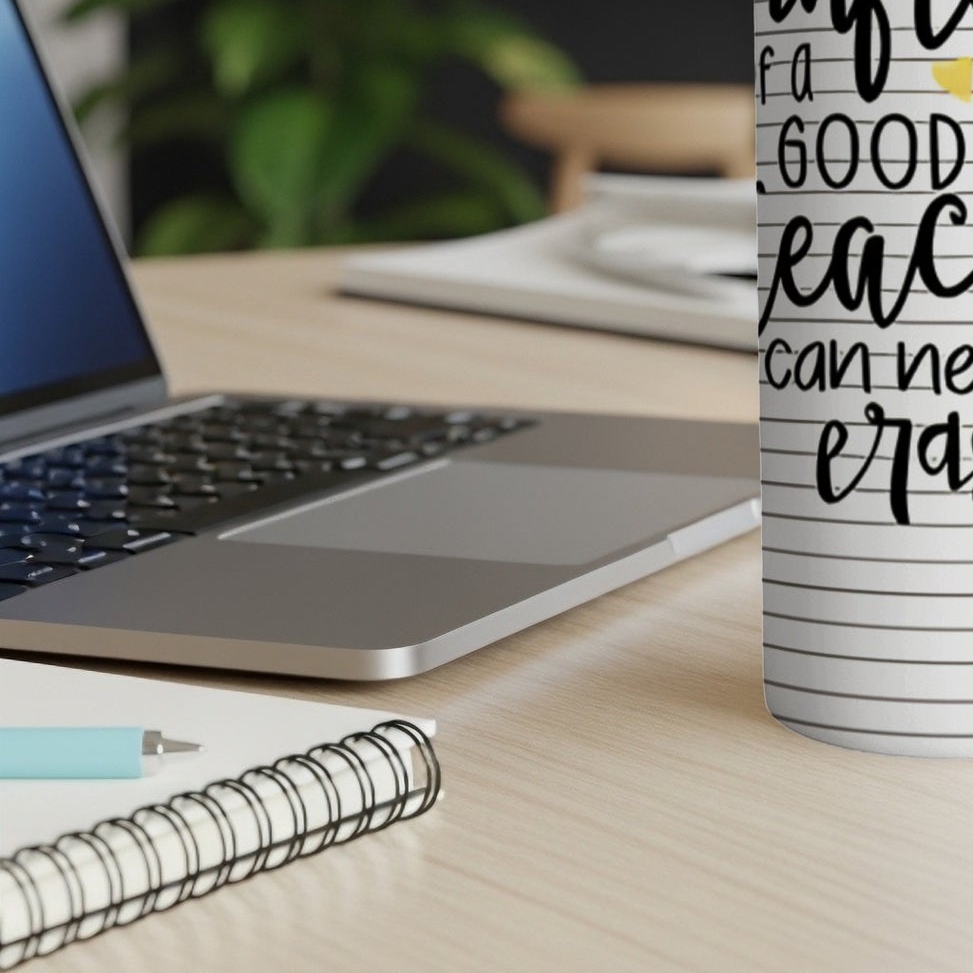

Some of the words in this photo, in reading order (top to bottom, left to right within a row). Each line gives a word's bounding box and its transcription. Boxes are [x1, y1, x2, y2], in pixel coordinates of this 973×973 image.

[759, 45, 775, 105] f
[790, 43, 813, 103] a
[777, 113, 966, 190] GOOD
[764, 338, 872, 394] can
